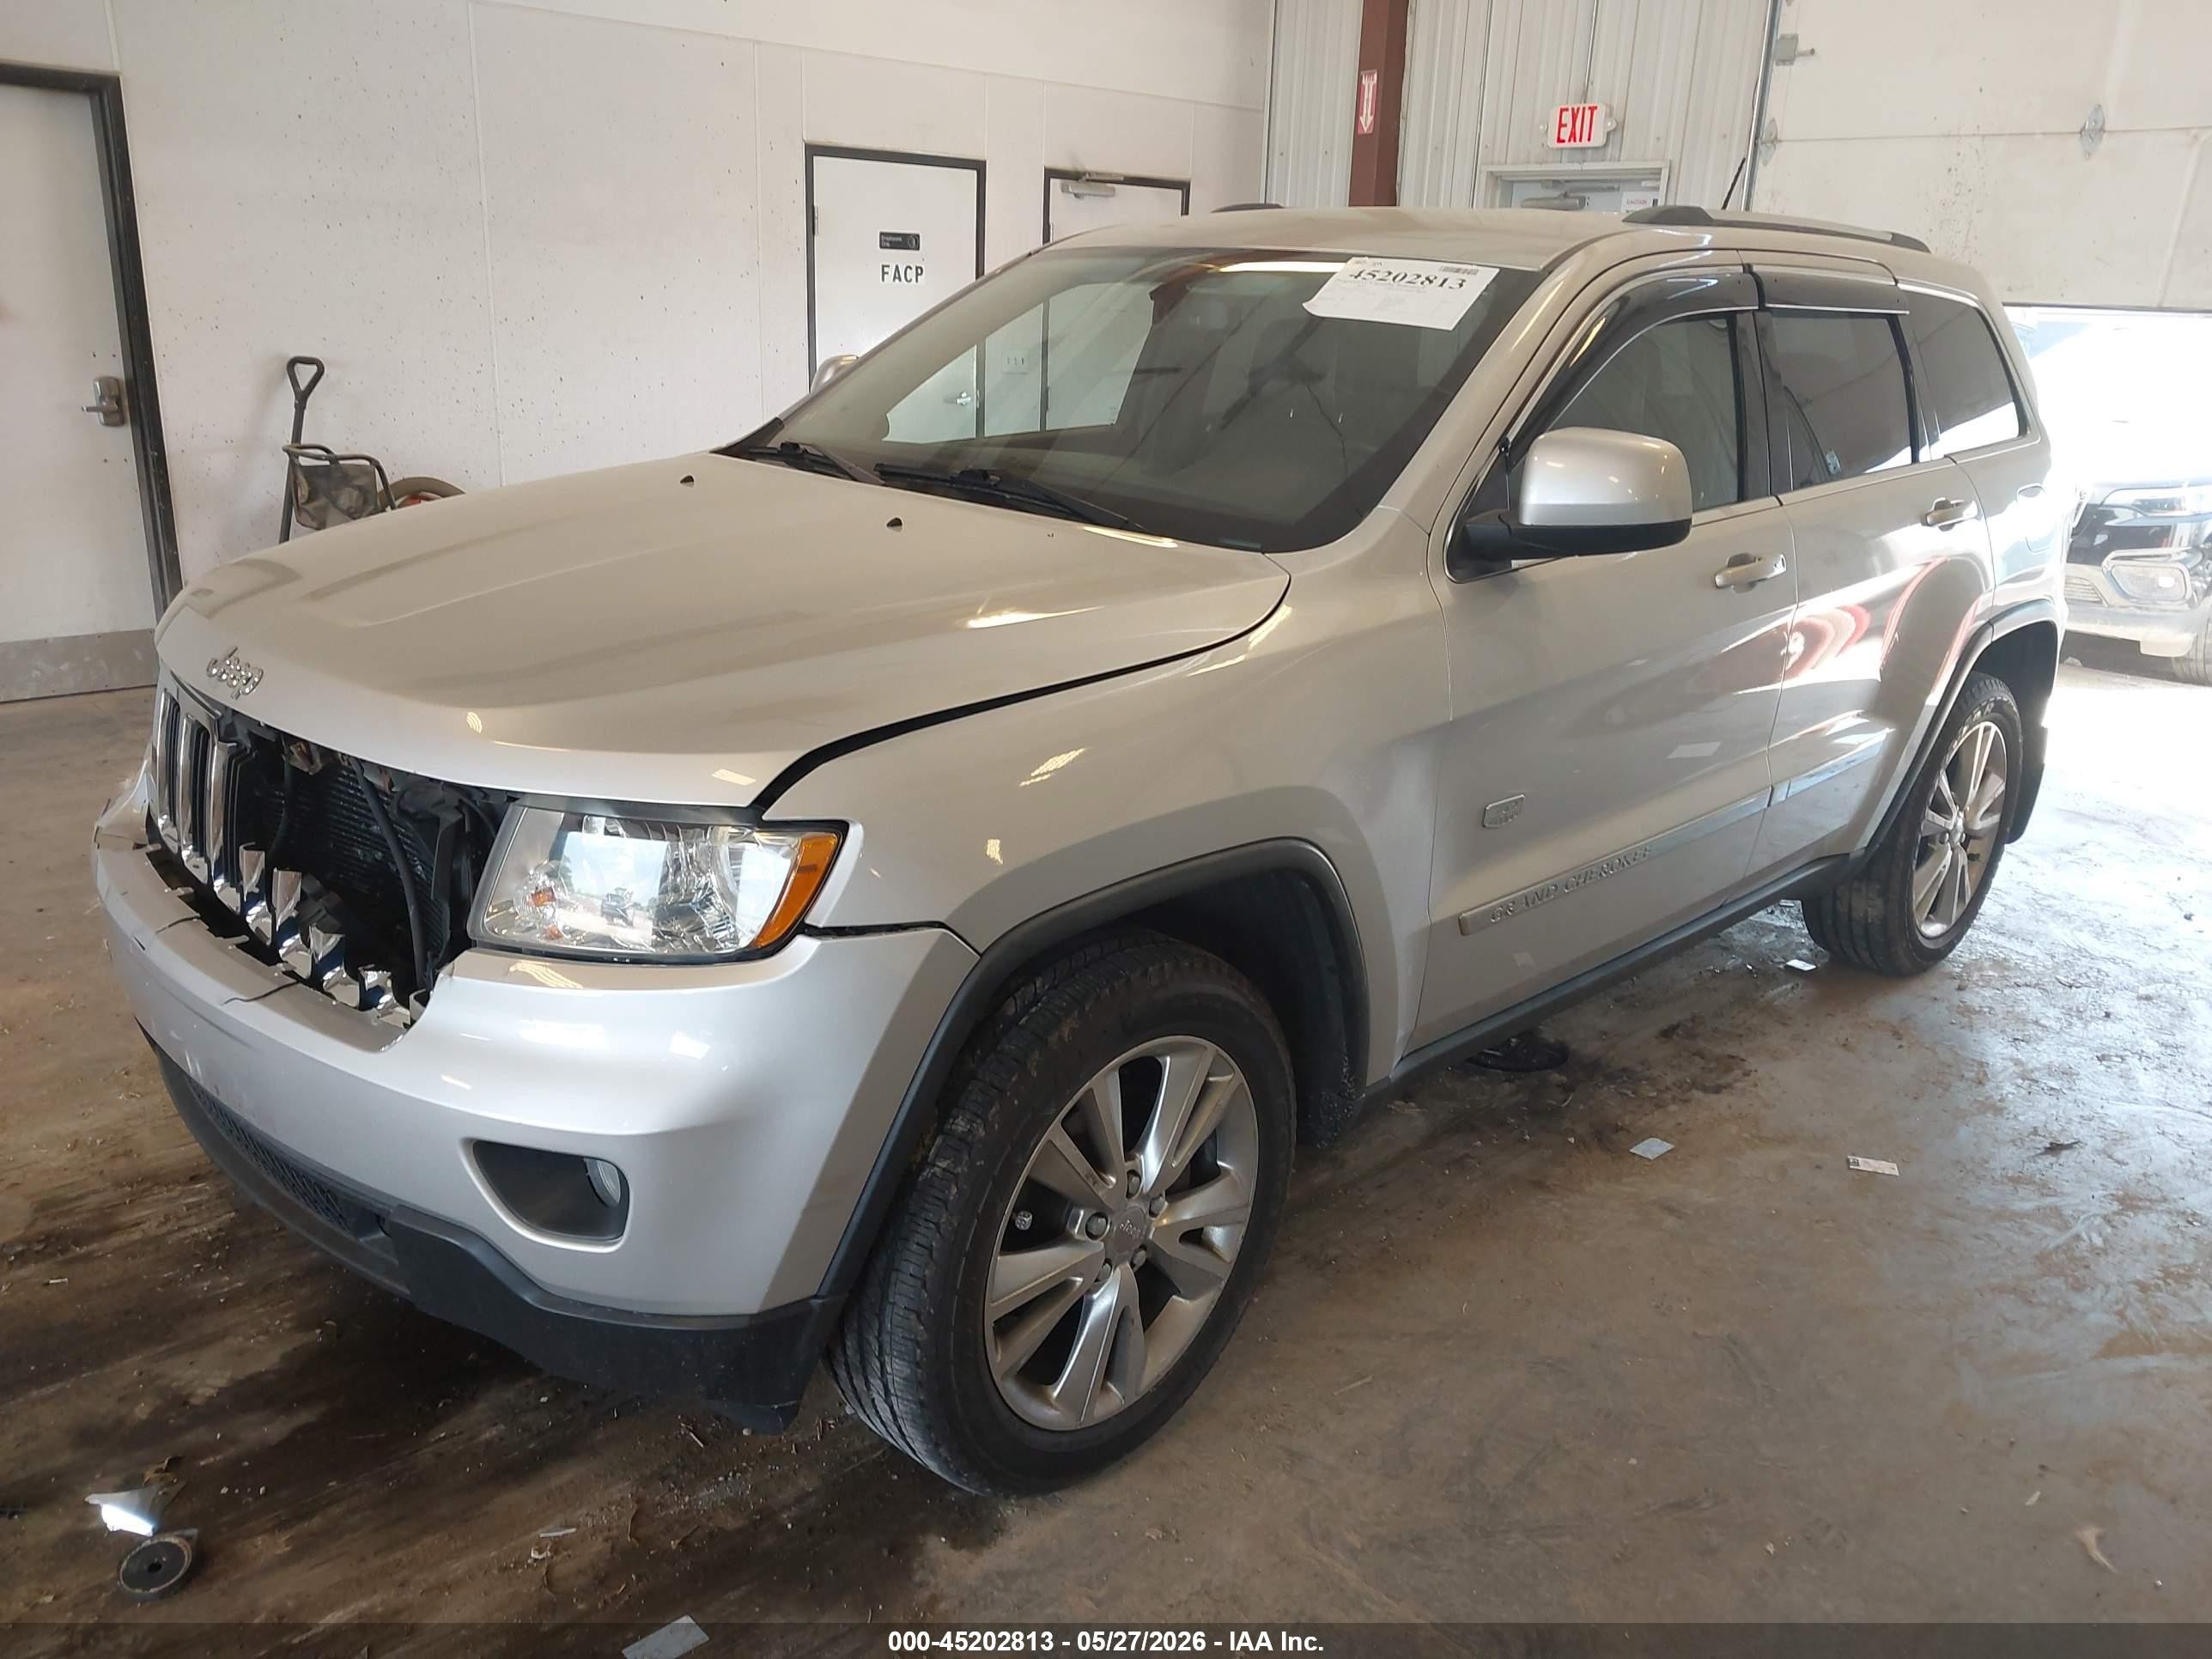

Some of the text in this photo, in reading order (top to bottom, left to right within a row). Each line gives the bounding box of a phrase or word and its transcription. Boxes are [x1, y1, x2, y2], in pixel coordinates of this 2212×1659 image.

[1556, 106, 1598, 143] EXIT
[881, 264, 924, 283] FACP
[1349, 268, 1467, 289] 45202813
[206, 646, 264, 701] Jeep
